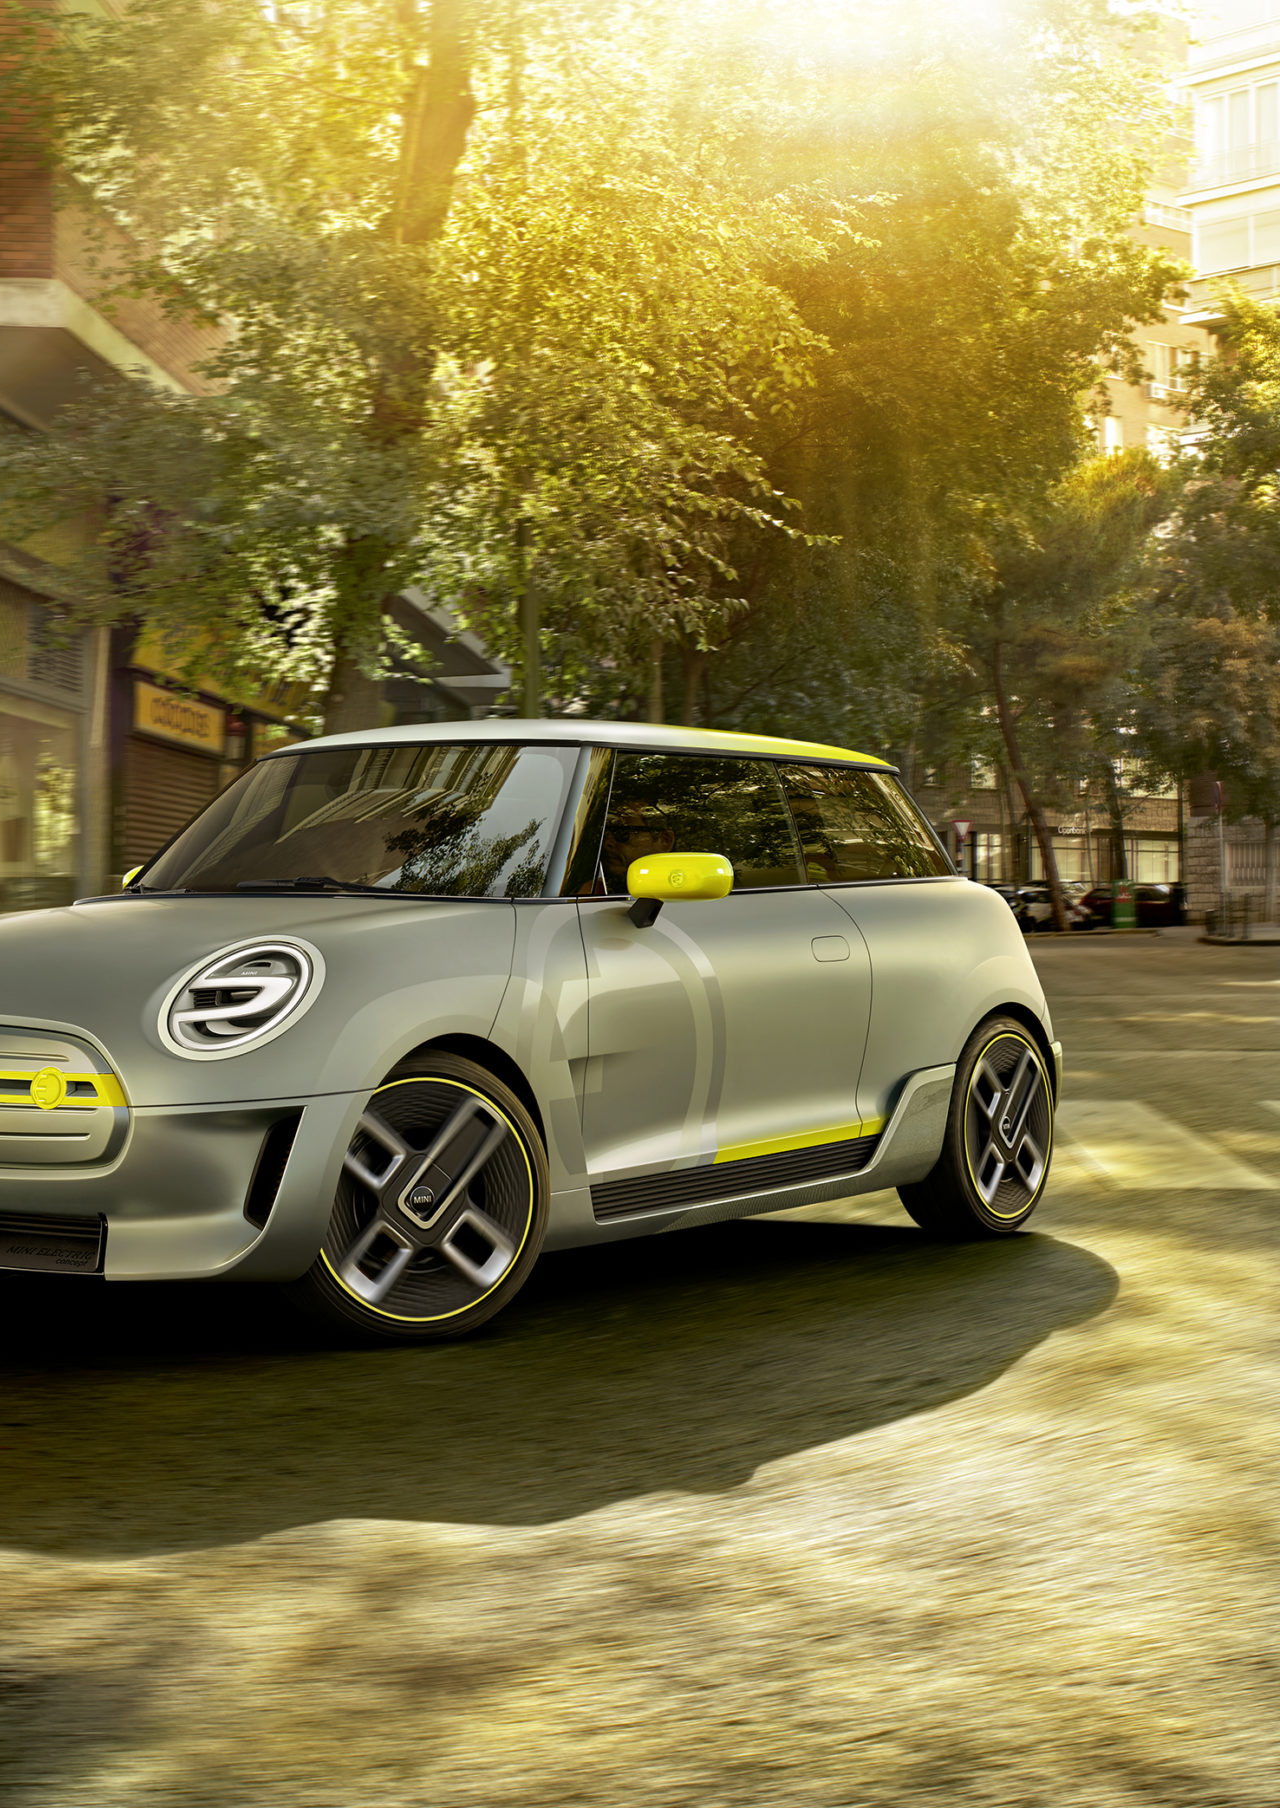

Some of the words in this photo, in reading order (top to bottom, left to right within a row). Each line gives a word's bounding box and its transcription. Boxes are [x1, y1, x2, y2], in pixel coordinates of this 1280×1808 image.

[413, 1195, 432, 1204] MINI
[5, 1245, 37, 1256] MINI
[36, 1248, 96, 1260] ELECTRIC
